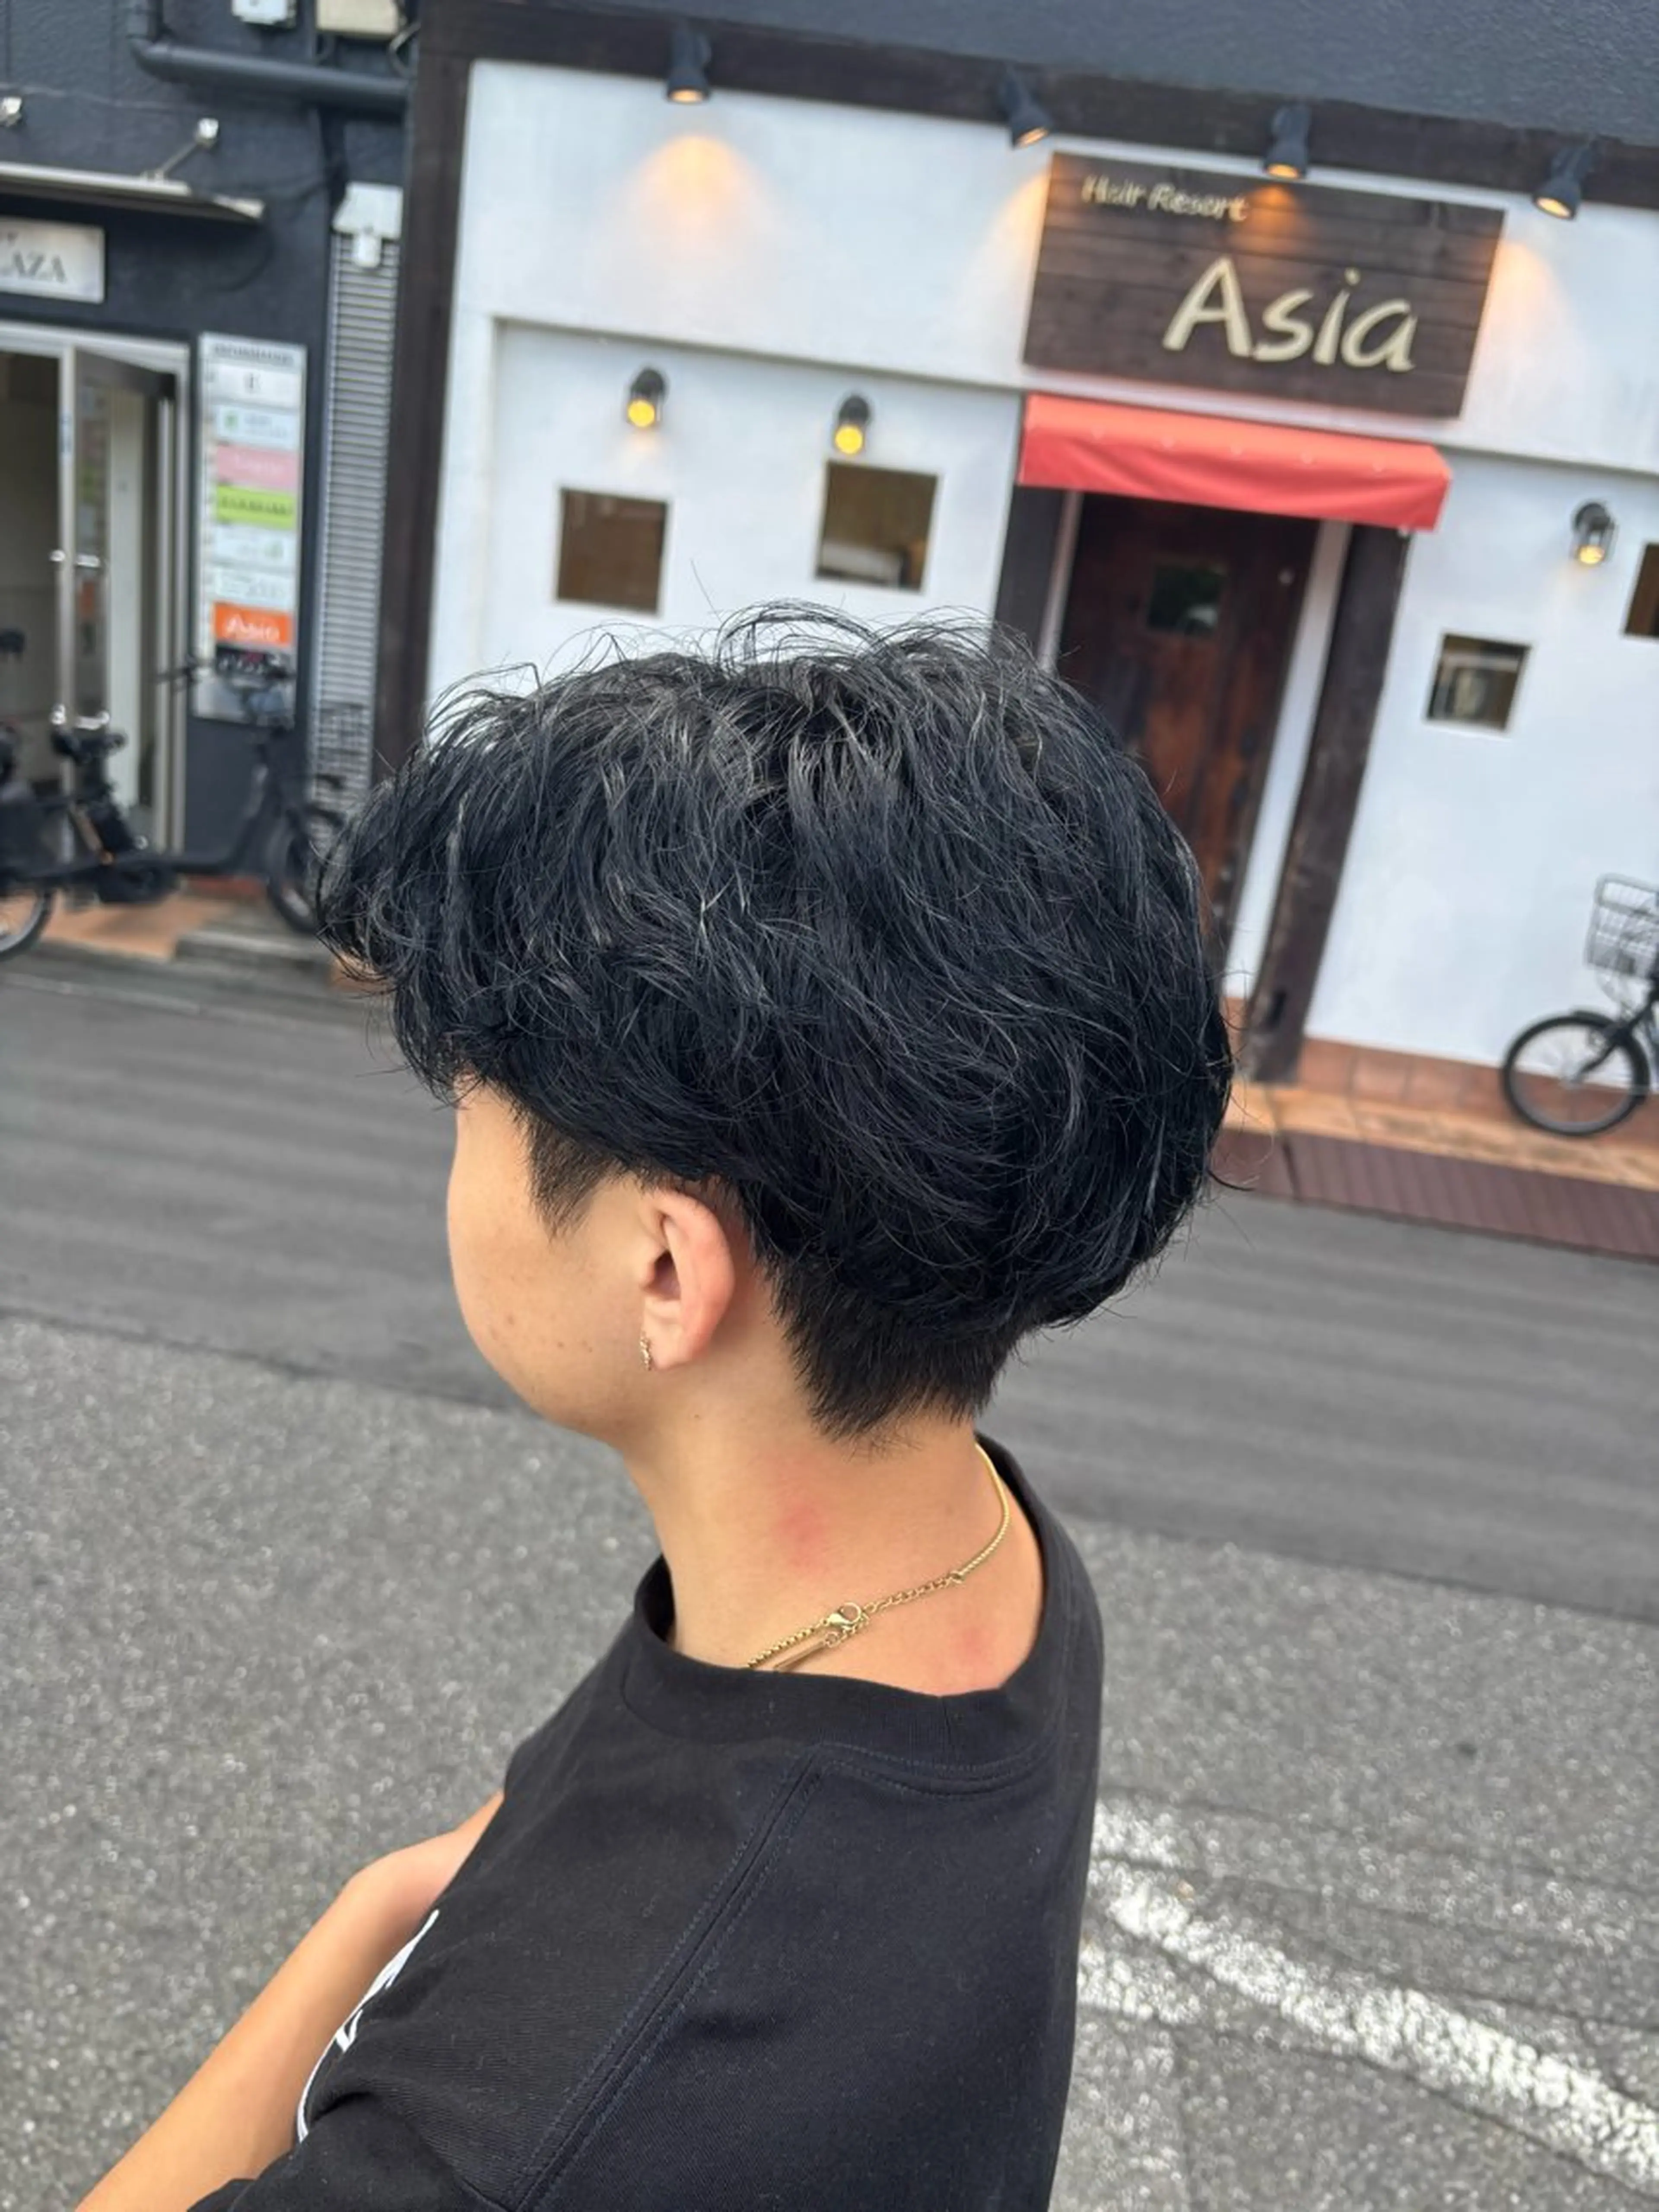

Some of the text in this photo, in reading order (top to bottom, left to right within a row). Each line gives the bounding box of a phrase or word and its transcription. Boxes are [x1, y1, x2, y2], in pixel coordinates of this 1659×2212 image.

[1081, 175, 1248, 222] Hair Resort
[1163, 257, 1416, 372] Asia
